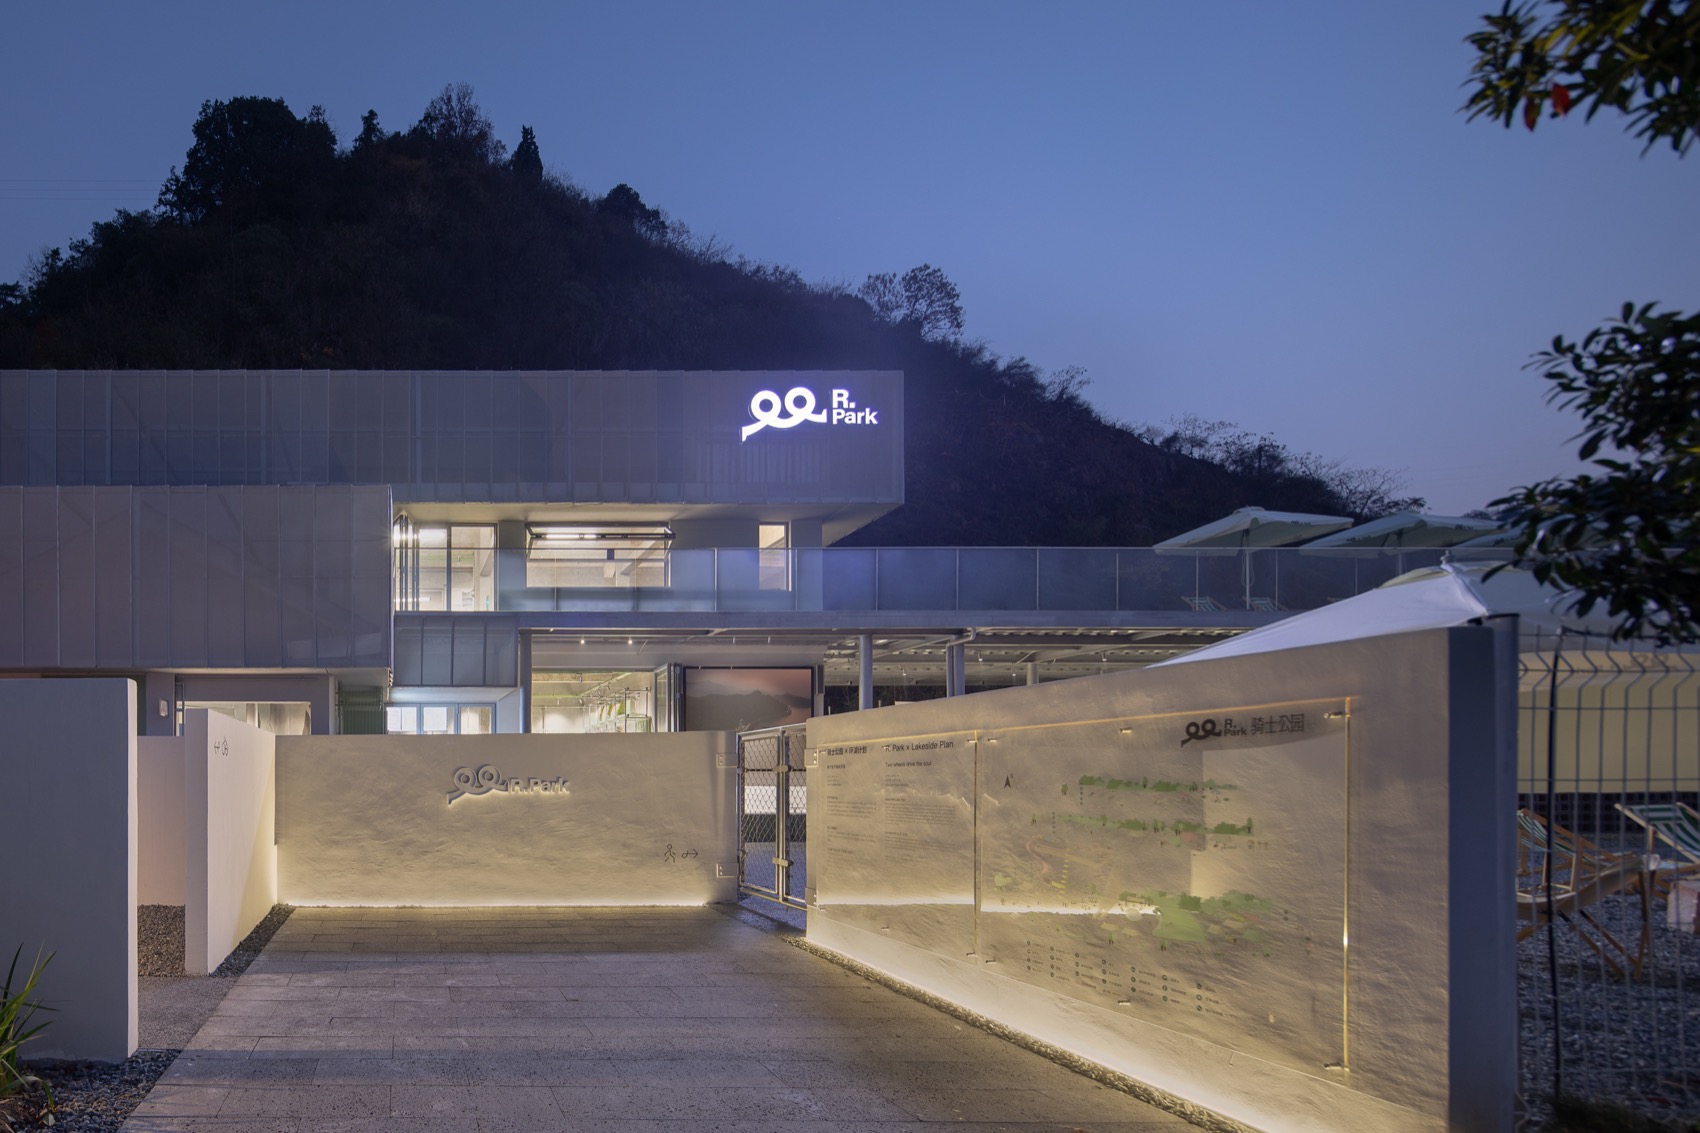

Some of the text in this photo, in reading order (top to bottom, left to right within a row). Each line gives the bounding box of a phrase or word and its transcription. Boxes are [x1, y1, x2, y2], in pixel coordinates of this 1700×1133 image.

[832, 389, 856, 408] R.
[832, 408, 878, 424] Park
[1224, 718, 1237, 729] R.
[1251, 713, 1304, 735] 骑士公园
[1224, 728, 1247, 736] Park
[892, 743, 904, 751] Park
[911, 741, 938, 751] Lakeside
[940, 740, 954, 749] Plan
